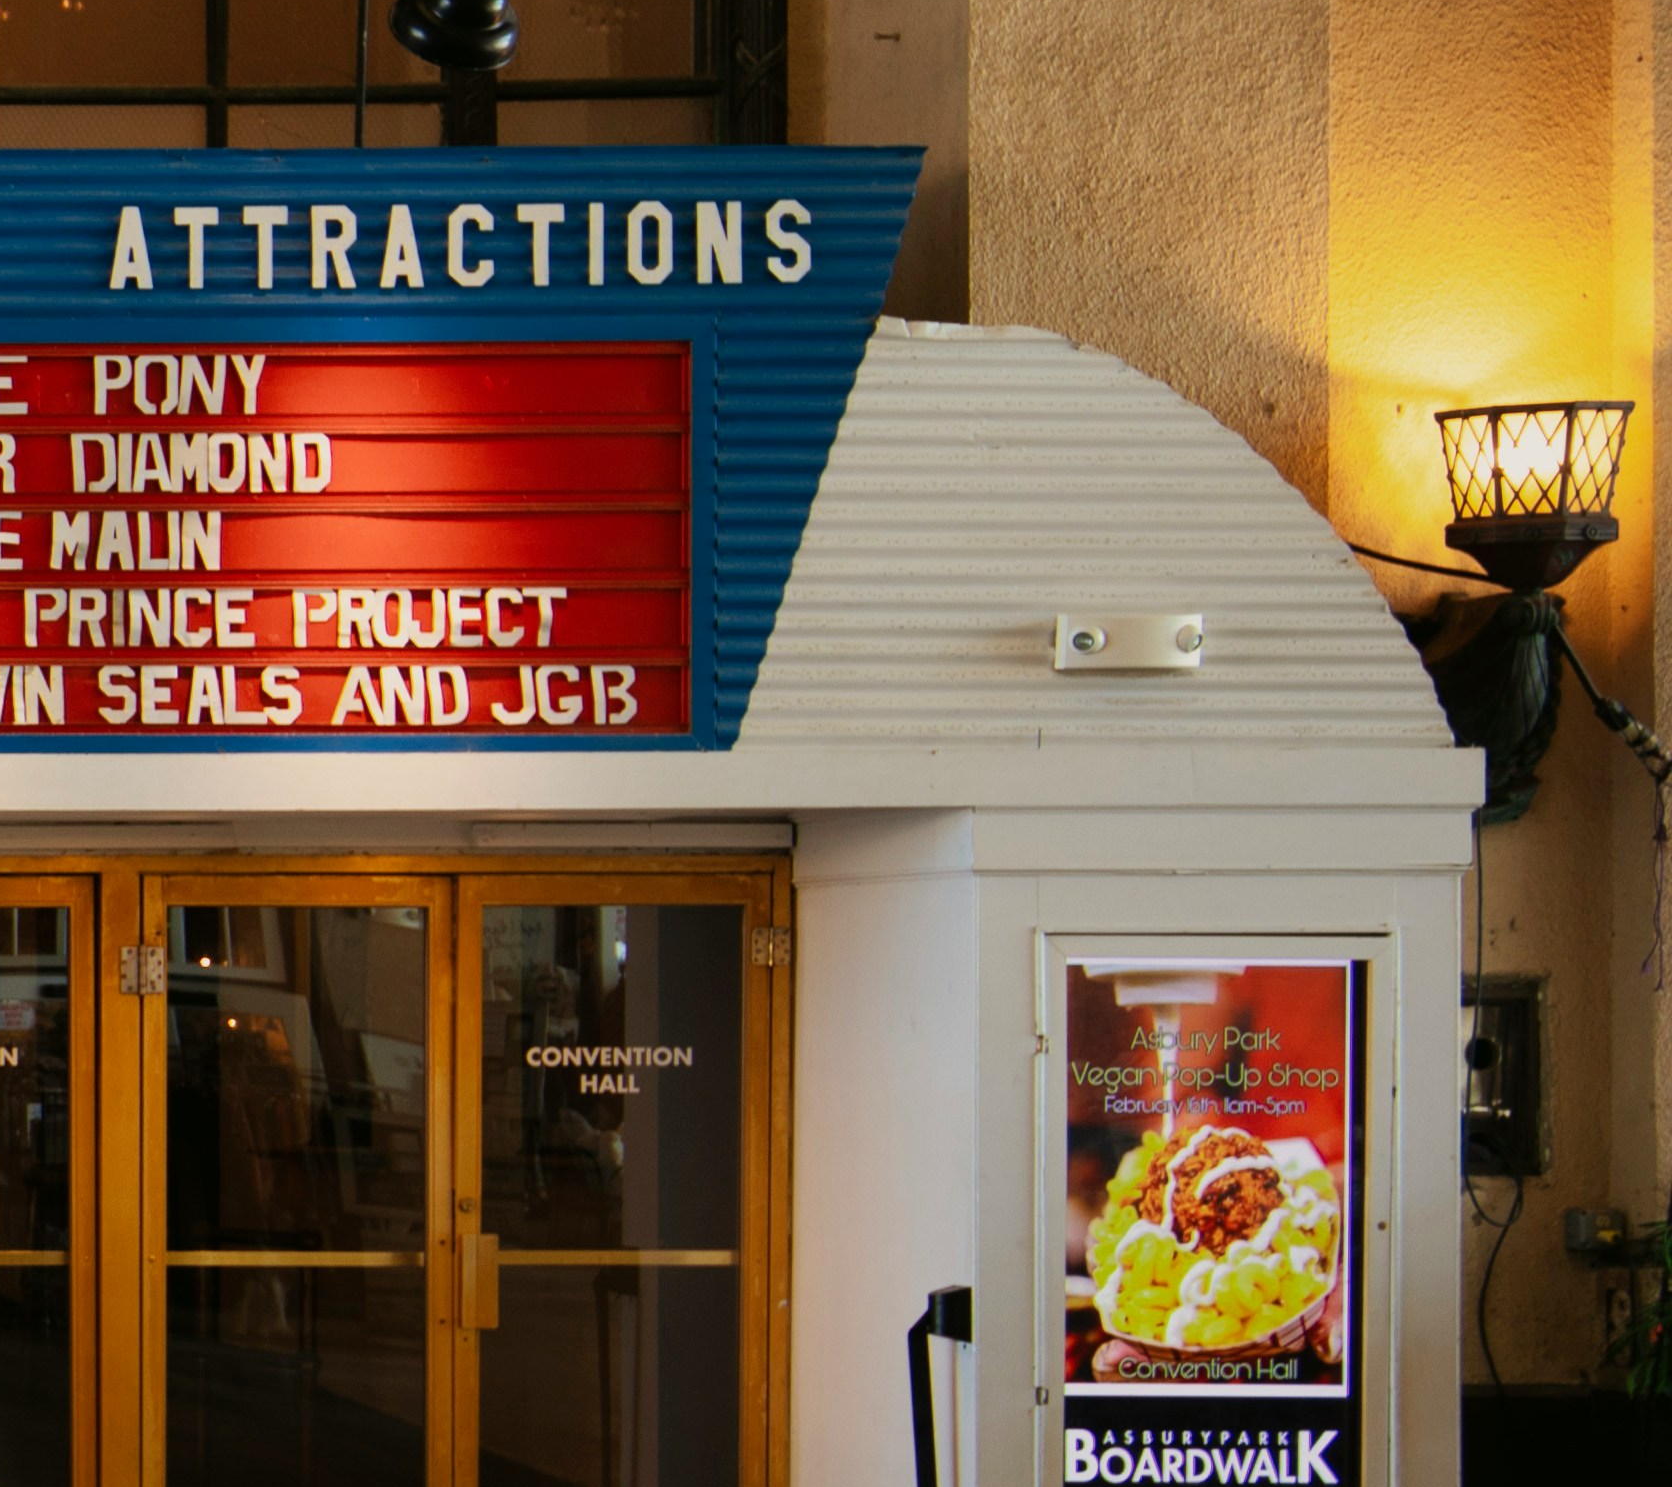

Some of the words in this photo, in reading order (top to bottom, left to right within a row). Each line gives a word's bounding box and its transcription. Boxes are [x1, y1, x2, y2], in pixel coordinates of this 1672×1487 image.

[109, 198, 813, 291] ATTRACTIONS
[94, 354, 266, 414] PONY
[71, 432, 333, 494] DIAMOND
[49, 510, 221, 571] MALIN
[23, 587, 256, 648] PRINCE
[291, 586, 568, 648] PROJECT
[97, 664, 303, 726] SEALS
[330, 664, 470, 726] AND
[490, 664, 638, 726] JGB
[526, 1046, 693, 1067] CONVENTION
[1131, 1026, 1218, 1055] Asbury
[1223, 1026, 1282, 1051] Park
[579, 1074, 640, 1094] HALL
[1071, 1061, 1158, 1094] Vegan
[1162, 1061, 1262, 1091] Pop-Up
[1268, 1061, 1340, 1091] Shop
[1104, 1095, 1184, 1114] February
[1118, 1357, 1253, 1380] Convention
[1256, 1357, 1299, 1380] Hall
[1064, 1427, 1340, 1485] BOARDWALK
